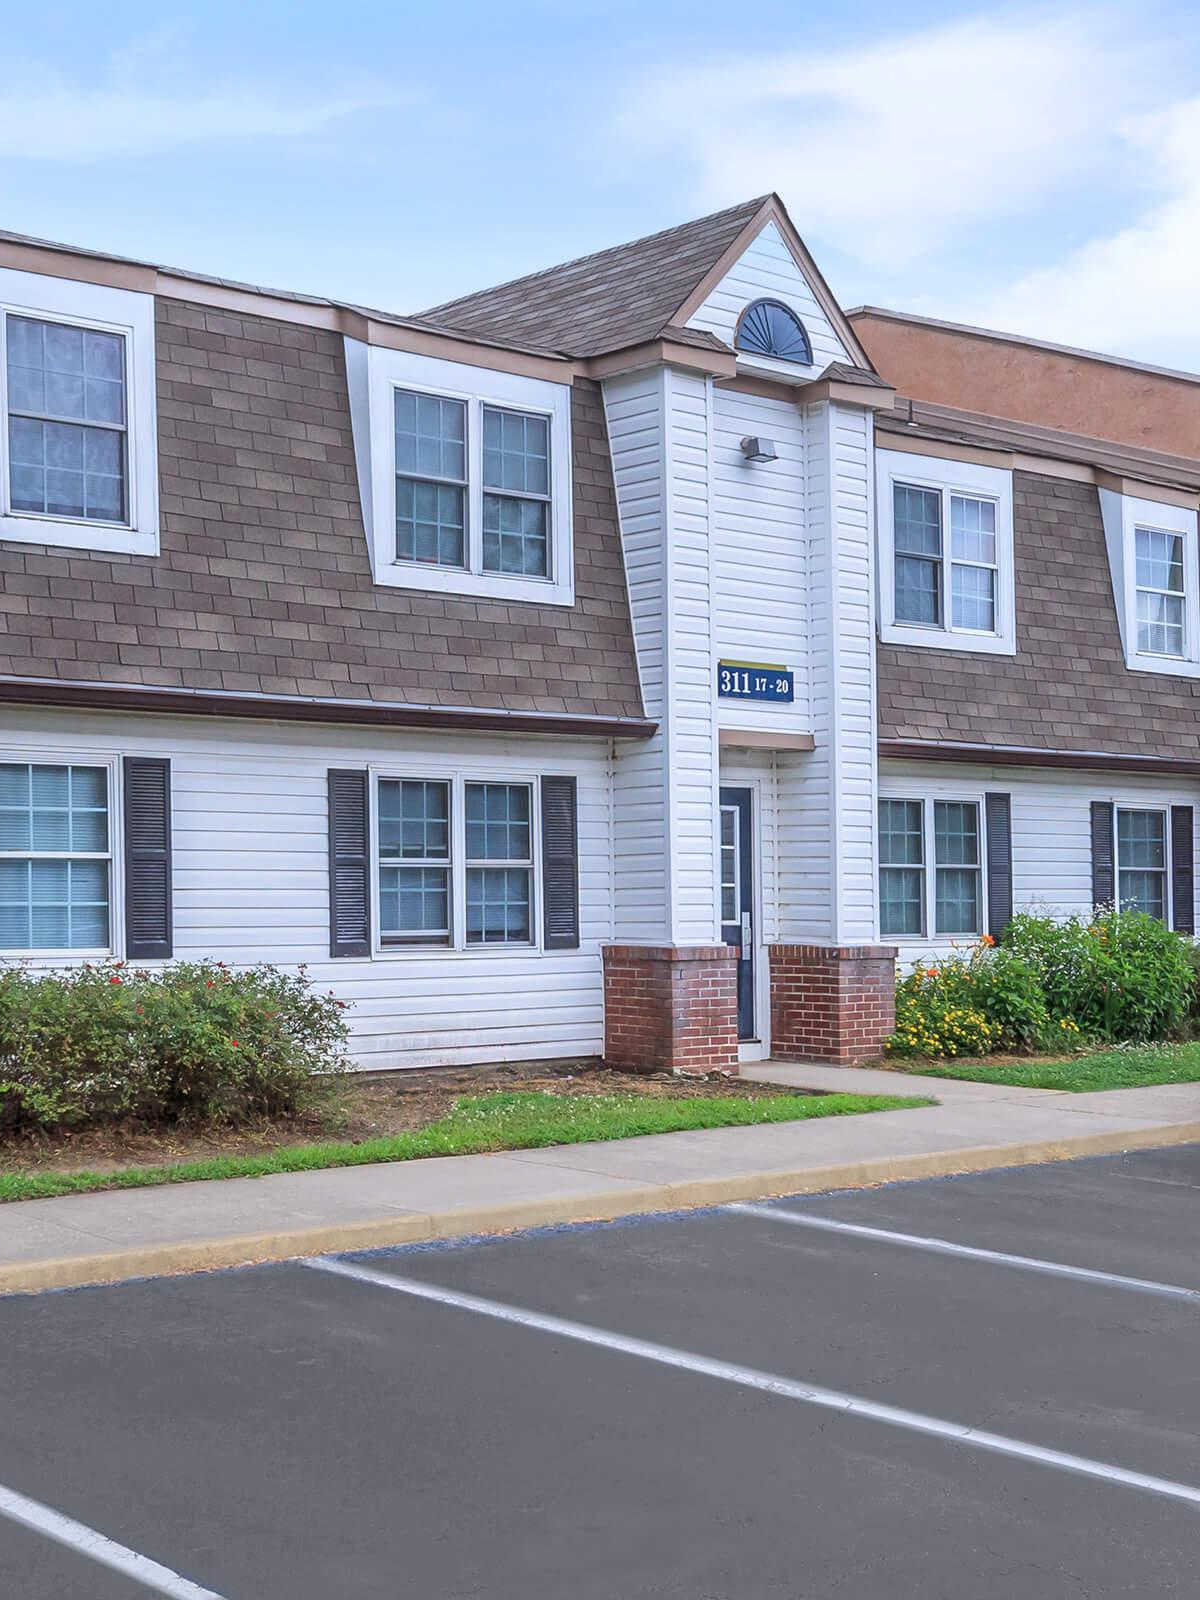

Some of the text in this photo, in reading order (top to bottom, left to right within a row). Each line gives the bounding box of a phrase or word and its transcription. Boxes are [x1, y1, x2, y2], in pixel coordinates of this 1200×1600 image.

[721, 670, 751, 694] 311
[755, 678, 767, 692] 17
[775, 679, 789, 694] 20
